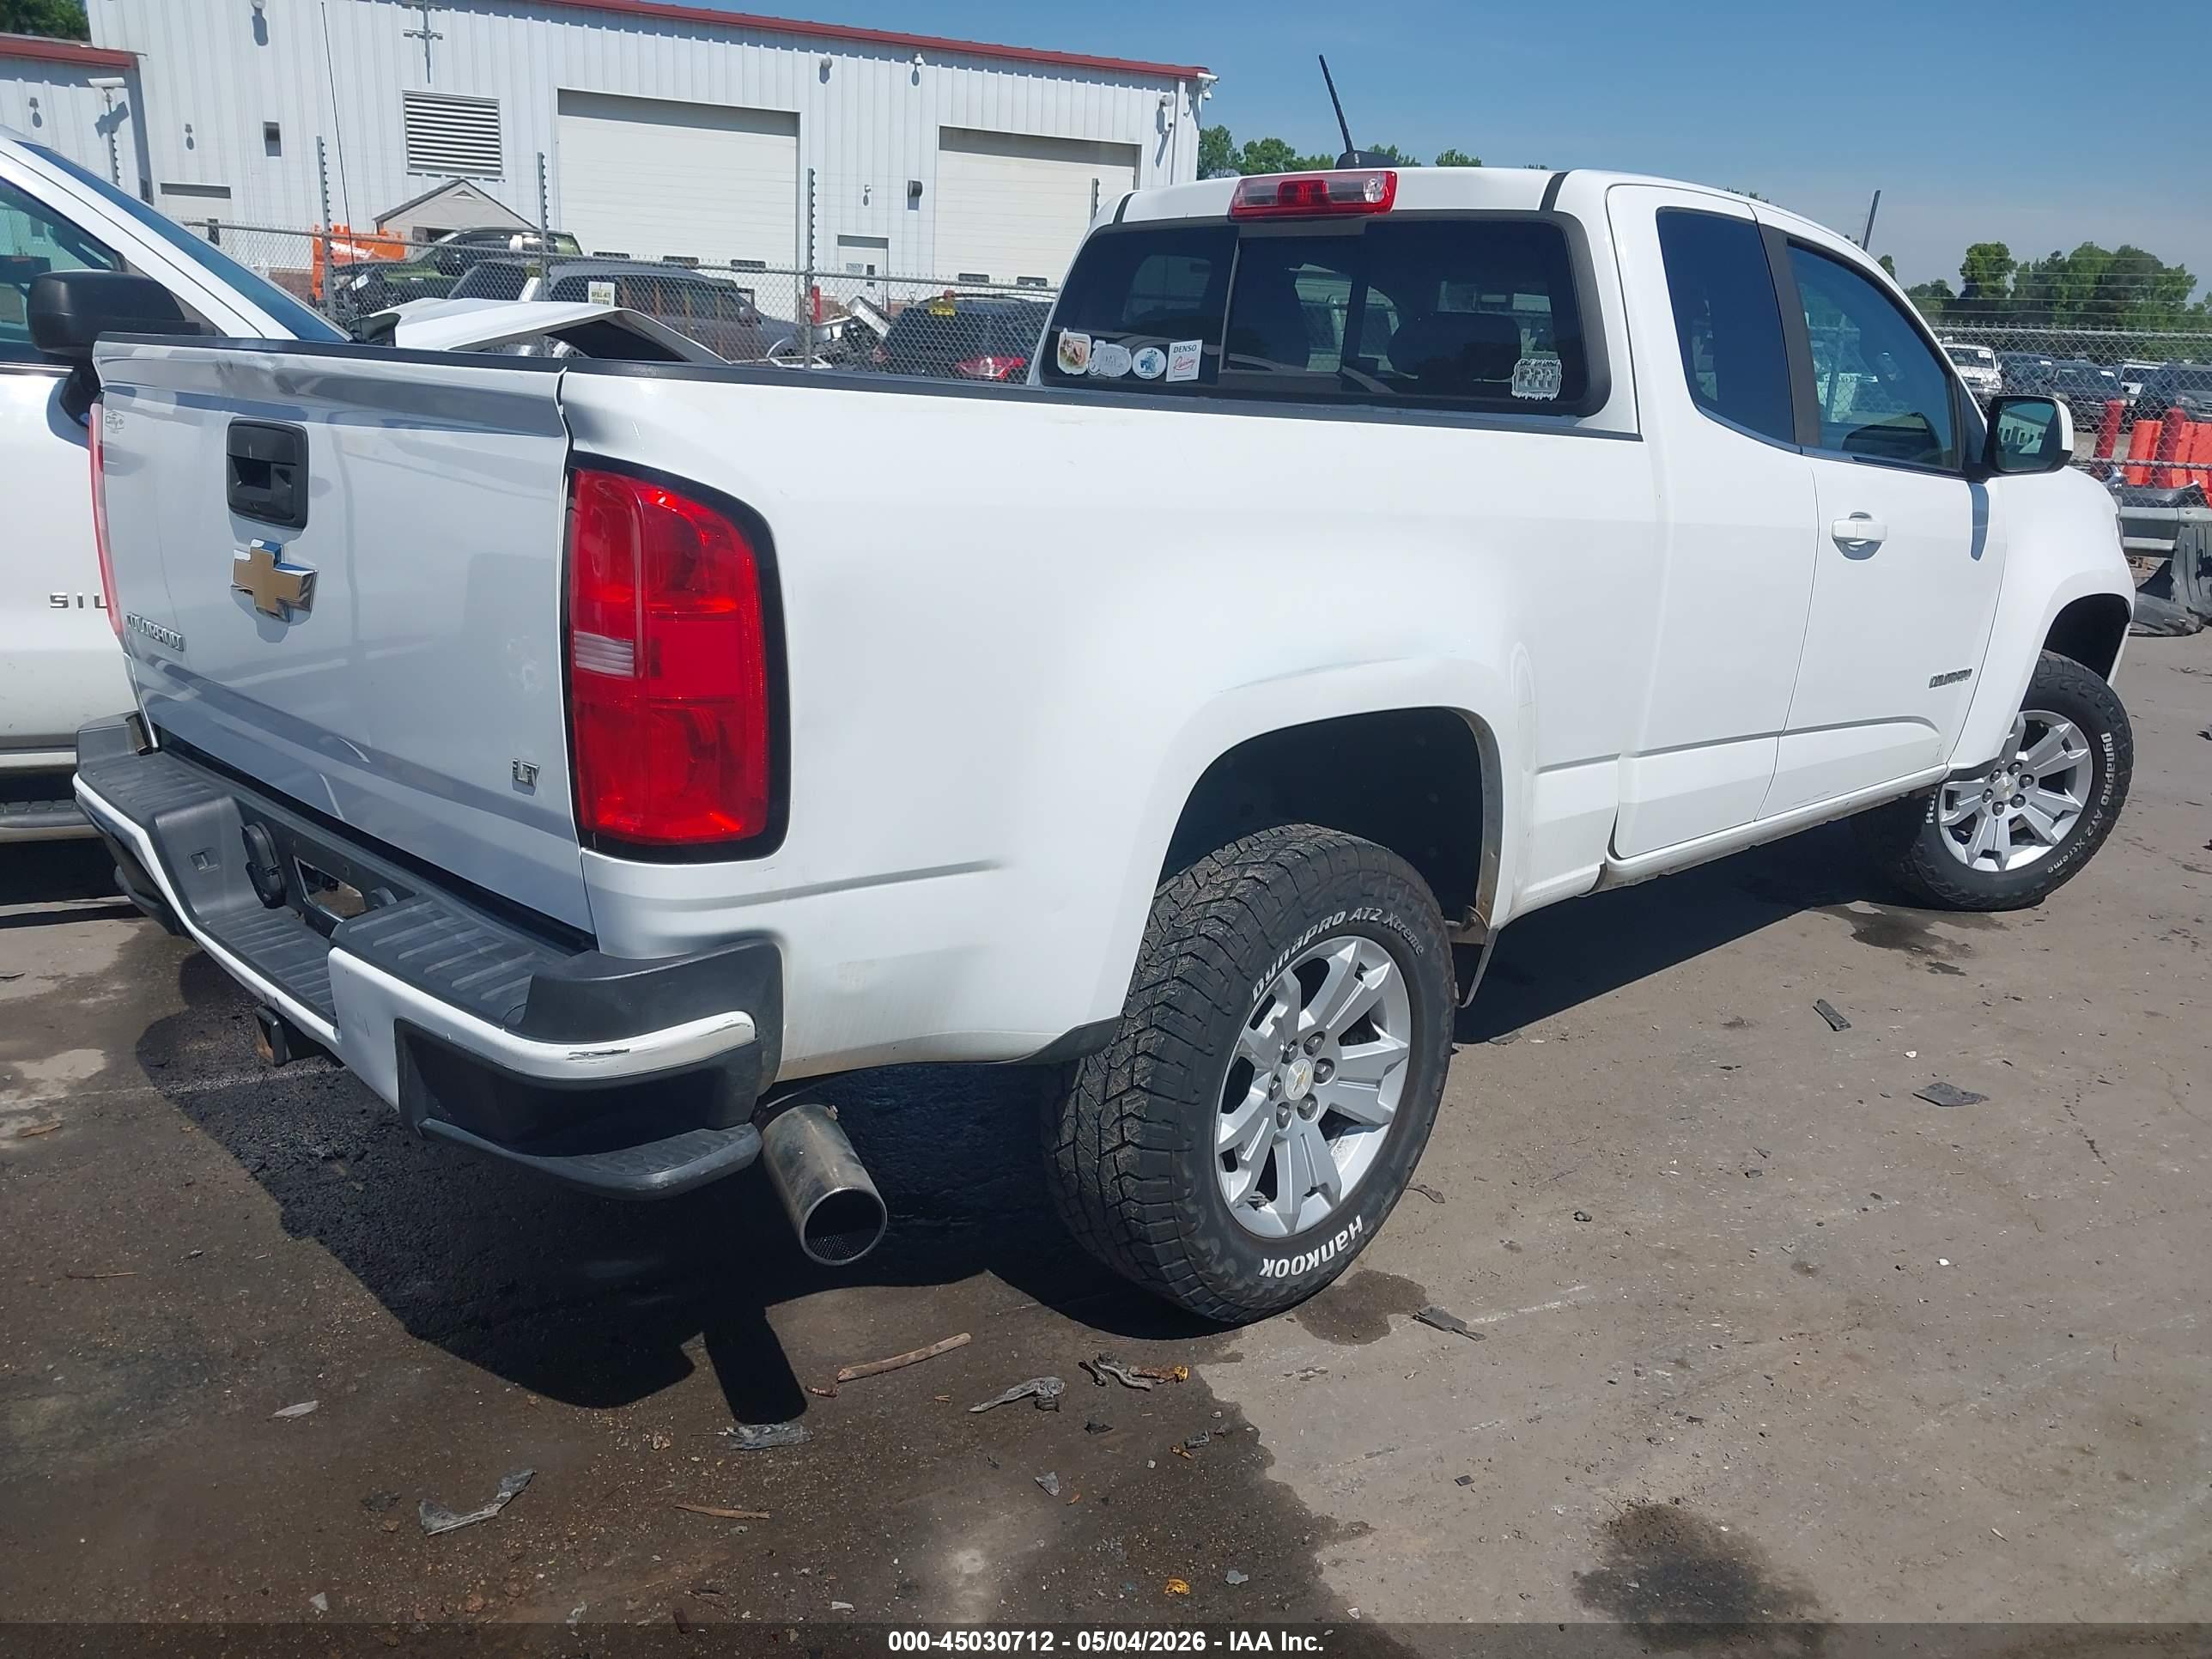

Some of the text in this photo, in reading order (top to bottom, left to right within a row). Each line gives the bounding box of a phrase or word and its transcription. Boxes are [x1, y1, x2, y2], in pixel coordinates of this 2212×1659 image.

[1173, 344, 1197, 353] DENSO
[512, 758, 540, 788] LT
[2047, 837, 2086, 873] Xtreme
[1348, 907, 1383, 922] AT2
[1382, 912, 1425, 957] Xtreme
